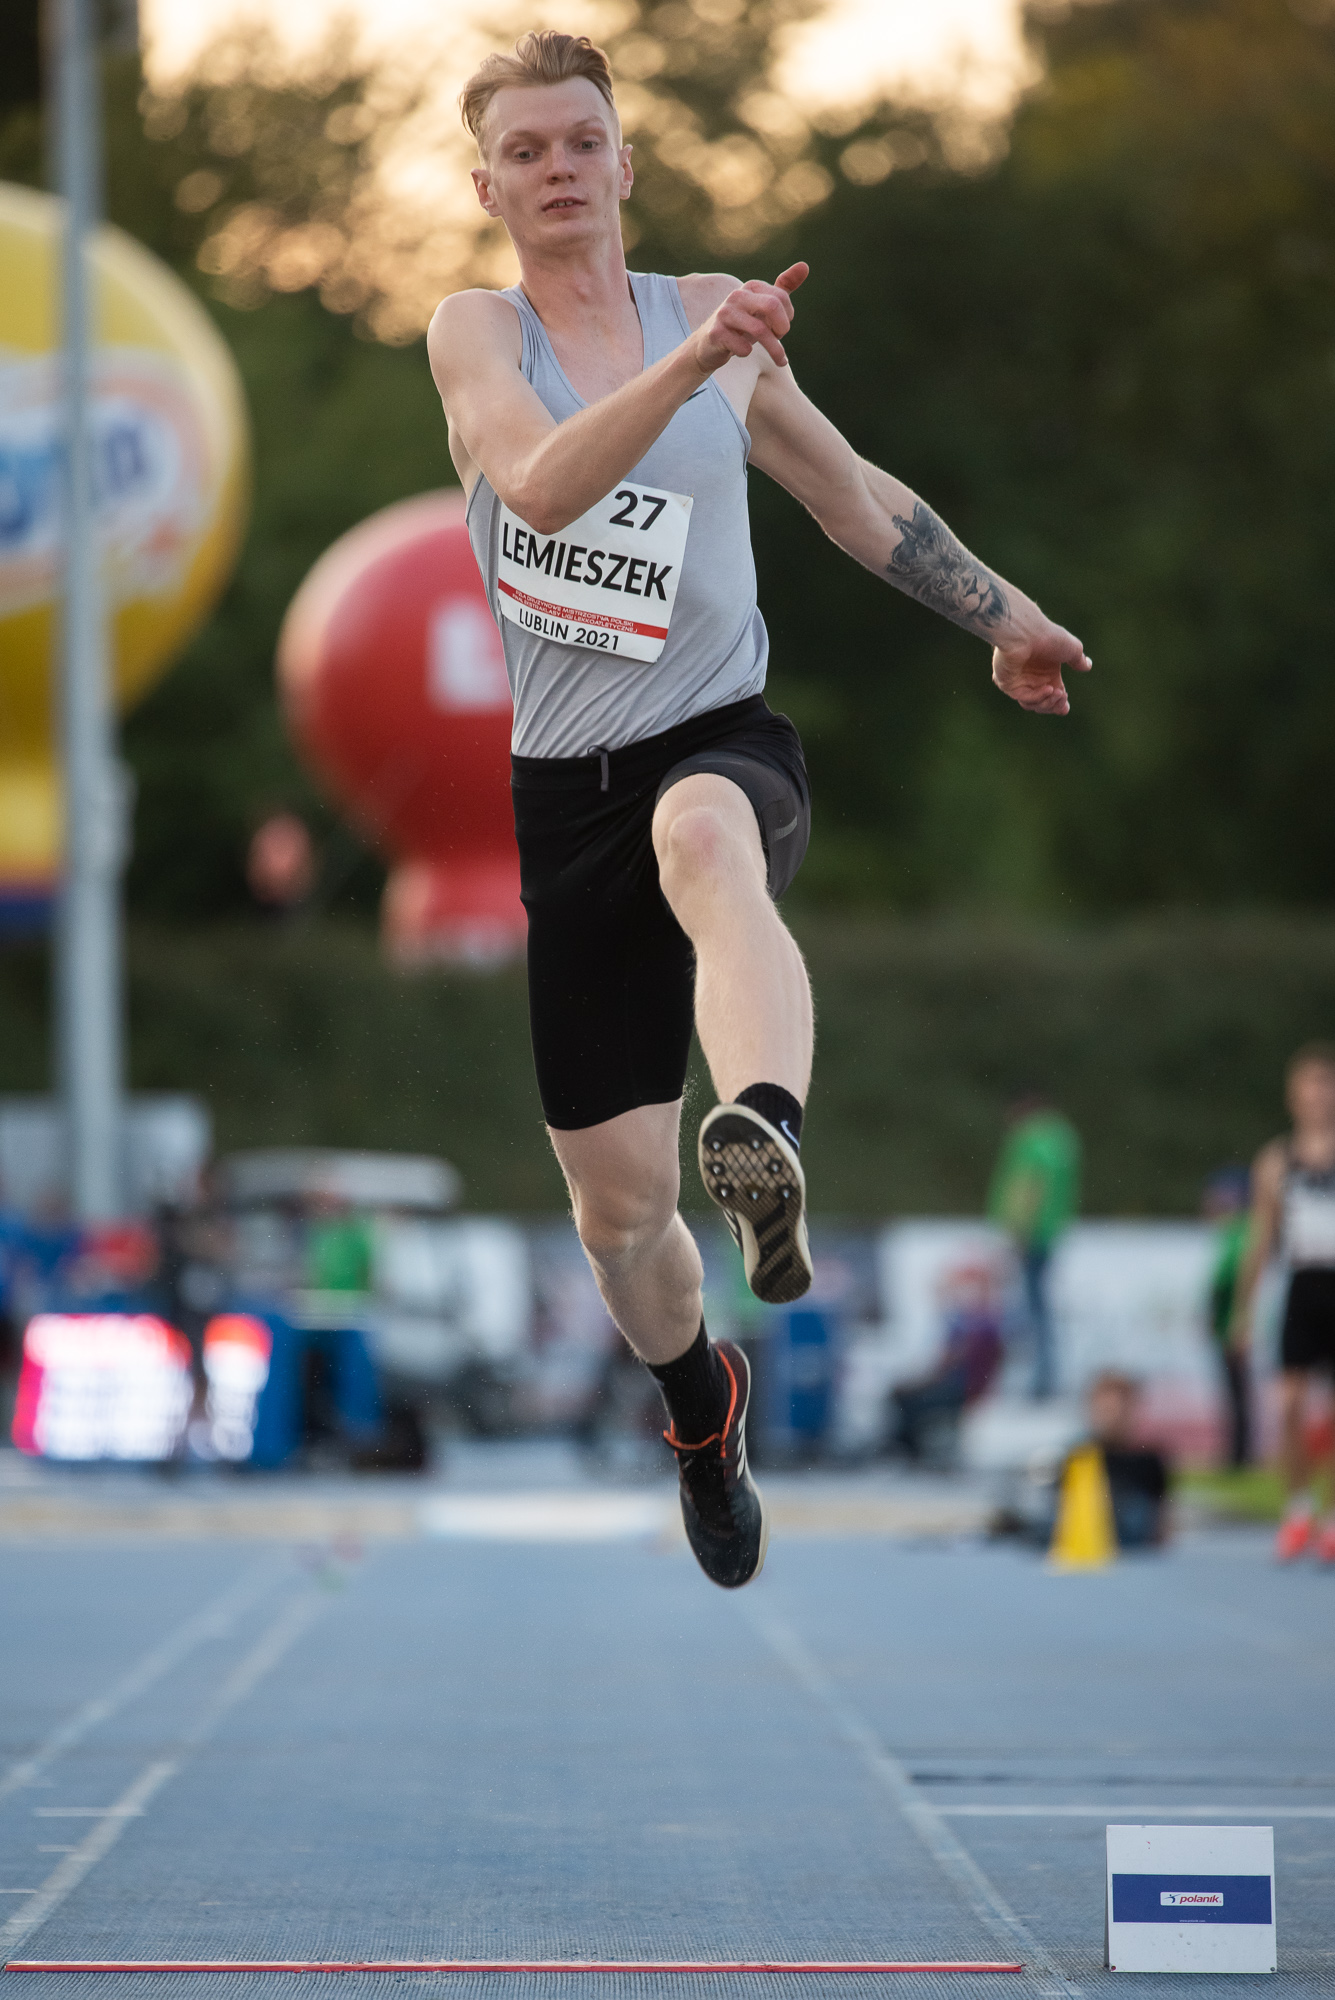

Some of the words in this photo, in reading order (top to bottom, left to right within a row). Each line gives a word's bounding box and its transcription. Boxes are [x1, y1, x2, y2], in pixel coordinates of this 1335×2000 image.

[609, 490, 668, 531] 27
[502, 522, 673, 601] LEMIESZEK
[519, 608, 570, 640] LUBLIN
[573, 627, 620, 650] 2021
[1179, 1894, 1220, 1904] polanik
